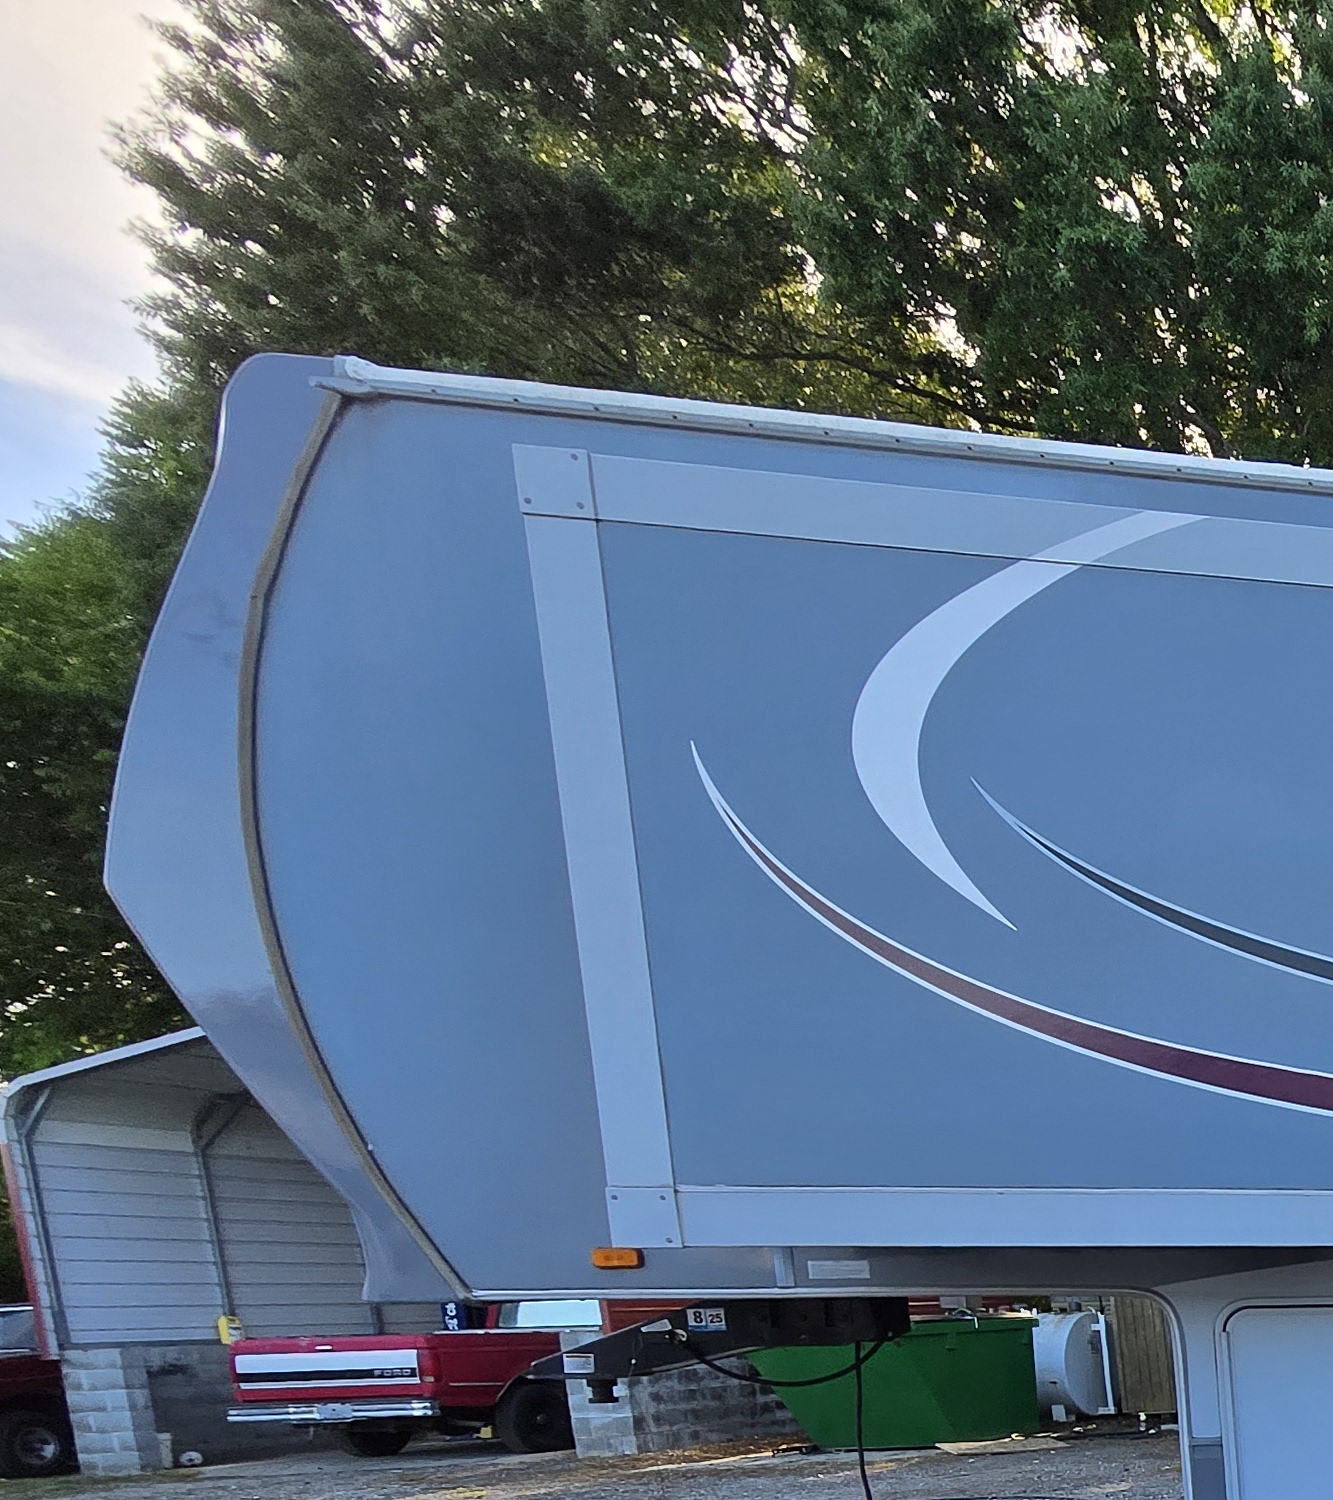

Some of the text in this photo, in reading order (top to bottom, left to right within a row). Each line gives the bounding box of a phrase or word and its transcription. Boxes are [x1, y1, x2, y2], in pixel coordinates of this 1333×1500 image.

[692, 1310, 723, 1324] 8 25
[373, 1369, 411, 1377] FORD
